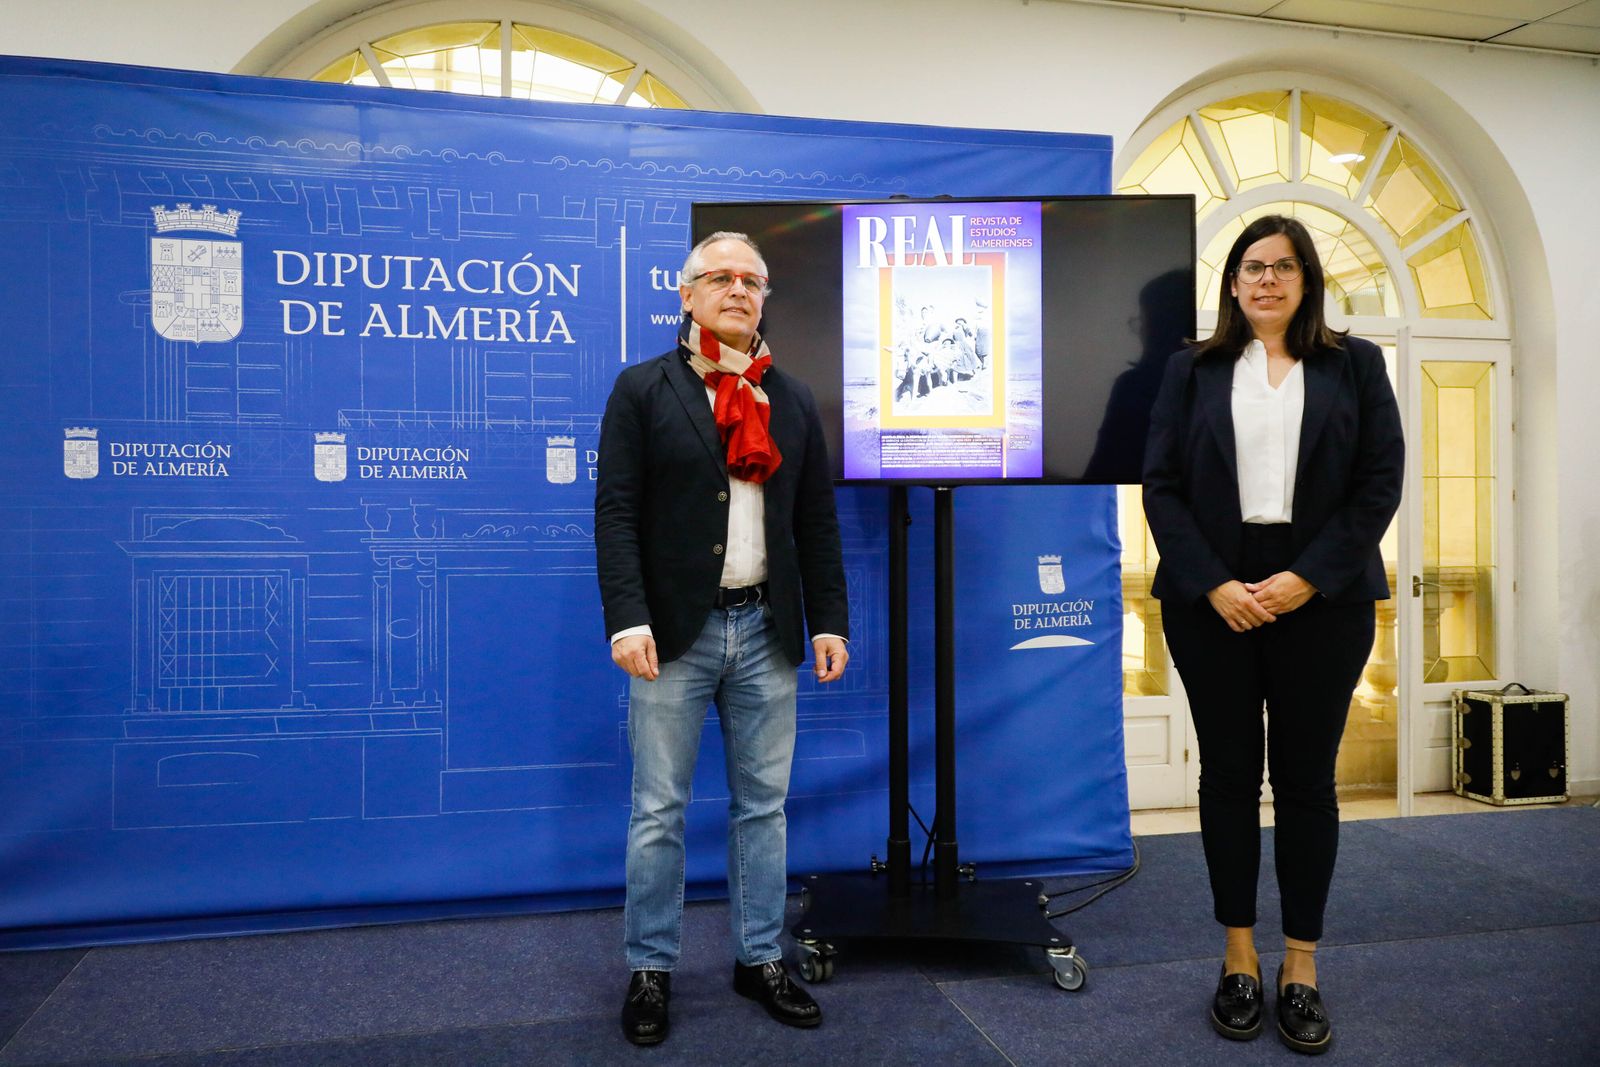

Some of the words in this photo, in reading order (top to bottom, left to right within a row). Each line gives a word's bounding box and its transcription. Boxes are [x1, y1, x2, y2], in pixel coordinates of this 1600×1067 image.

[970, 217, 1008, 226] REVISTA
[1009, 216, 1022, 225] DE
[970, 228, 1017, 237] ESTUDIOS
[856, 215, 976, 268] REAL
[970, 238, 1032, 248] ALMERIENSES
[273, 250, 581, 297] DIPUTACIÓN
[280, 300, 345, 337] DE
[359, 300, 576, 345] ALMERÍA
[110, 441, 231, 459] DIPUTACIÓN
[357, 445, 470, 463] DIPUTACIÓN
[112, 461, 138, 476] DE
[143, 460, 229, 477] ALMERÍA
[360, 465, 384, 479] DE
[388, 464, 469, 479] ALMERÍA
[1012, 599, 1094, 616] DIPUTACIÓN
[1014, 618, 1032, 630] DE
[1034, 612, 1092, 628] ALMERÍA
